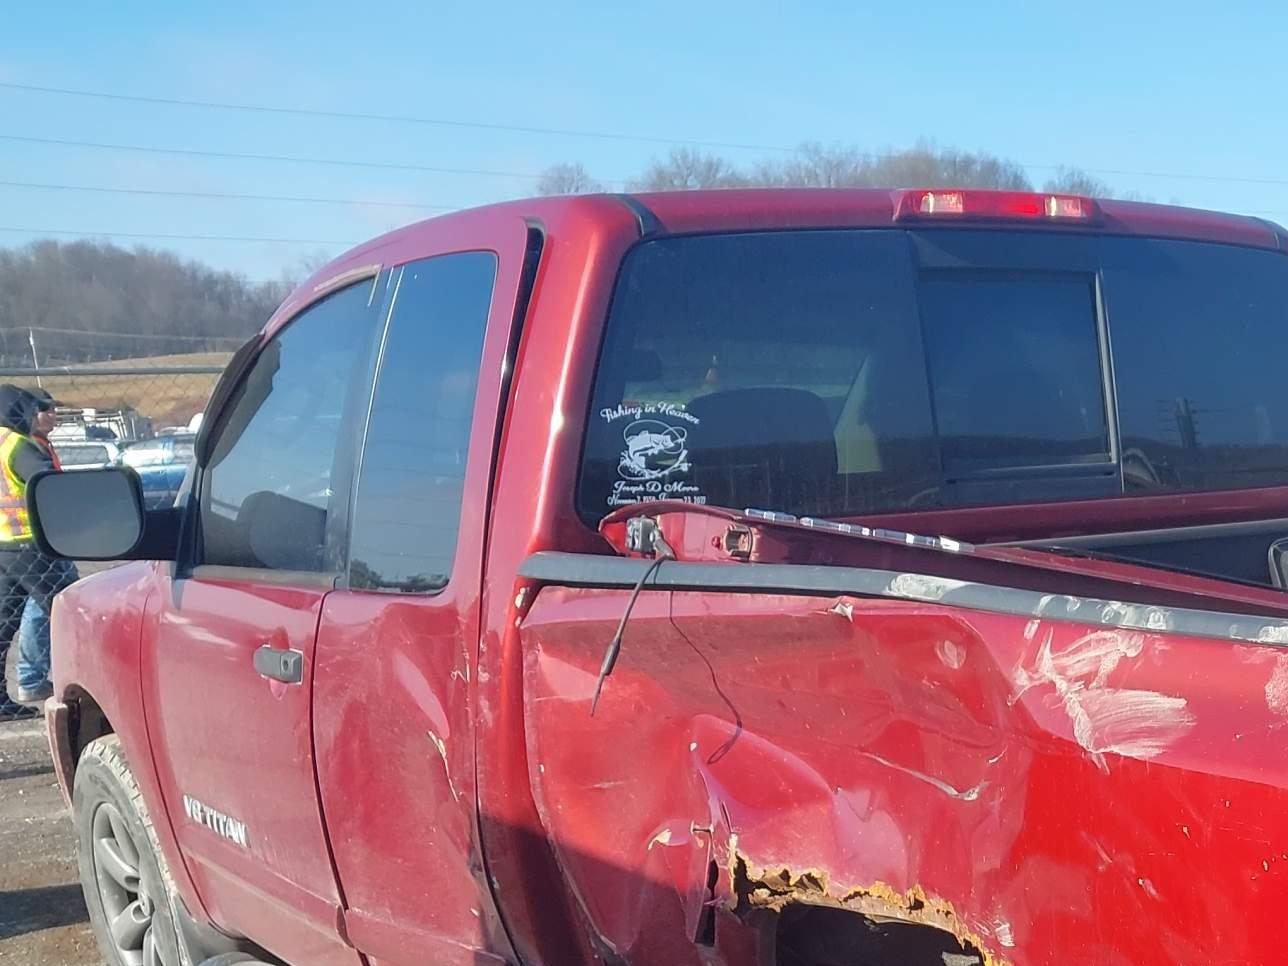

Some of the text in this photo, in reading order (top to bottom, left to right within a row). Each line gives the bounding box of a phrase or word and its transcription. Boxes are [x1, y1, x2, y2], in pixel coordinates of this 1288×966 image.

[600, 401, 701, 425] Fishing in Heaven
[645, 481, 661, 492] D
[203, 804, 251, 848] TITAN
